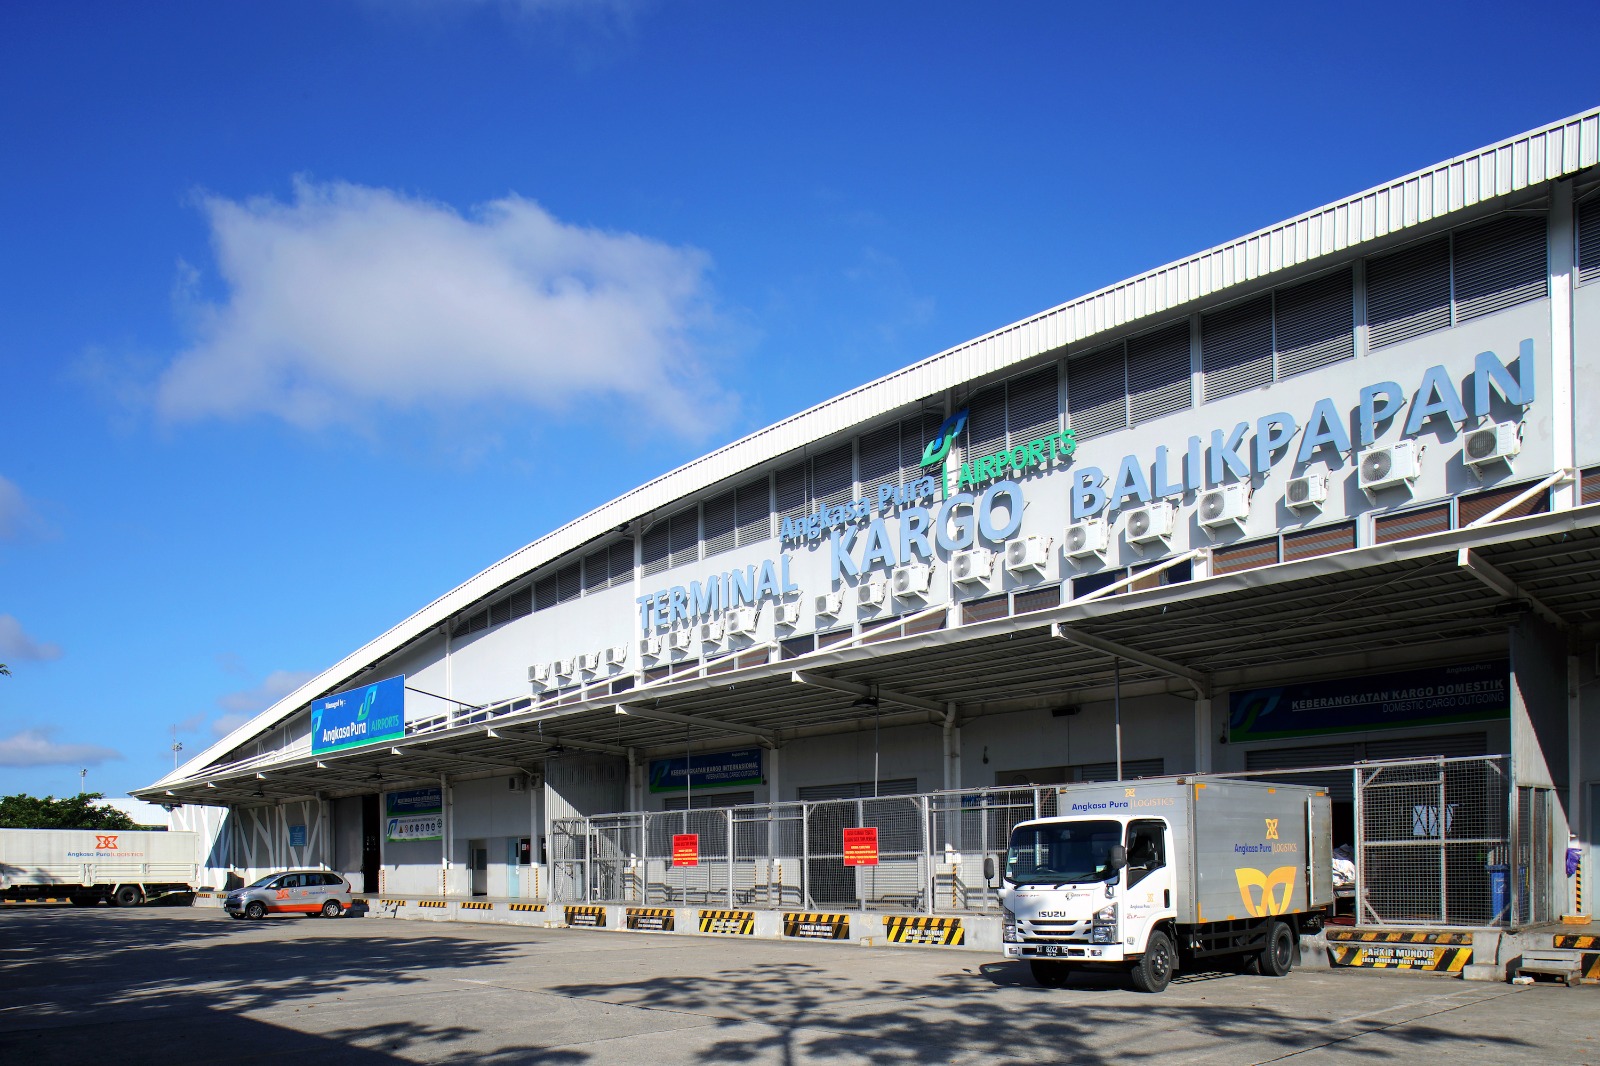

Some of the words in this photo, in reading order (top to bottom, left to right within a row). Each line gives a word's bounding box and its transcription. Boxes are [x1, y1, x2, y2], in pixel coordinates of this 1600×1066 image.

[957, 429, 1076, 489] AIRPORTS
[636, 554, 798, 630] TERMINAL
[831, 480, 1024, 581] KARGO
[1073, 338, 1535, 519] BALIKPAPAN
[780, 497, 871, 542] Angkasa
[878, 475, 935, 511] Pura
[1292, 691, 1390, 710] KEBERANGKATAN
[1392, 686, 1434, 700] KARGO
[1438, 679, 1504, 695] DOMESTIK
[1383, 700, 1425, 713] DOMESTIC
[1427, 696, 1456, 710] CARGO
[1458, 692, 1504, 706] OUTGOING
[371, 715, 399, 731] AIRPORTS
[1072, 803, 1106, 812] Angkasa
[1109, 801, 1128, 809] Pura
[1134, 798, 1174, 807] LOGISTICS
[1235, 843, 1258, 855] Angkasa
[1259, 843, 1271, 852] Pura
[1274, 843, 1297, 852] LOGISTICS
[1362, 948, 1394, 957] PARKIR
[1396, 949, 1434, 958] MUNDUR
